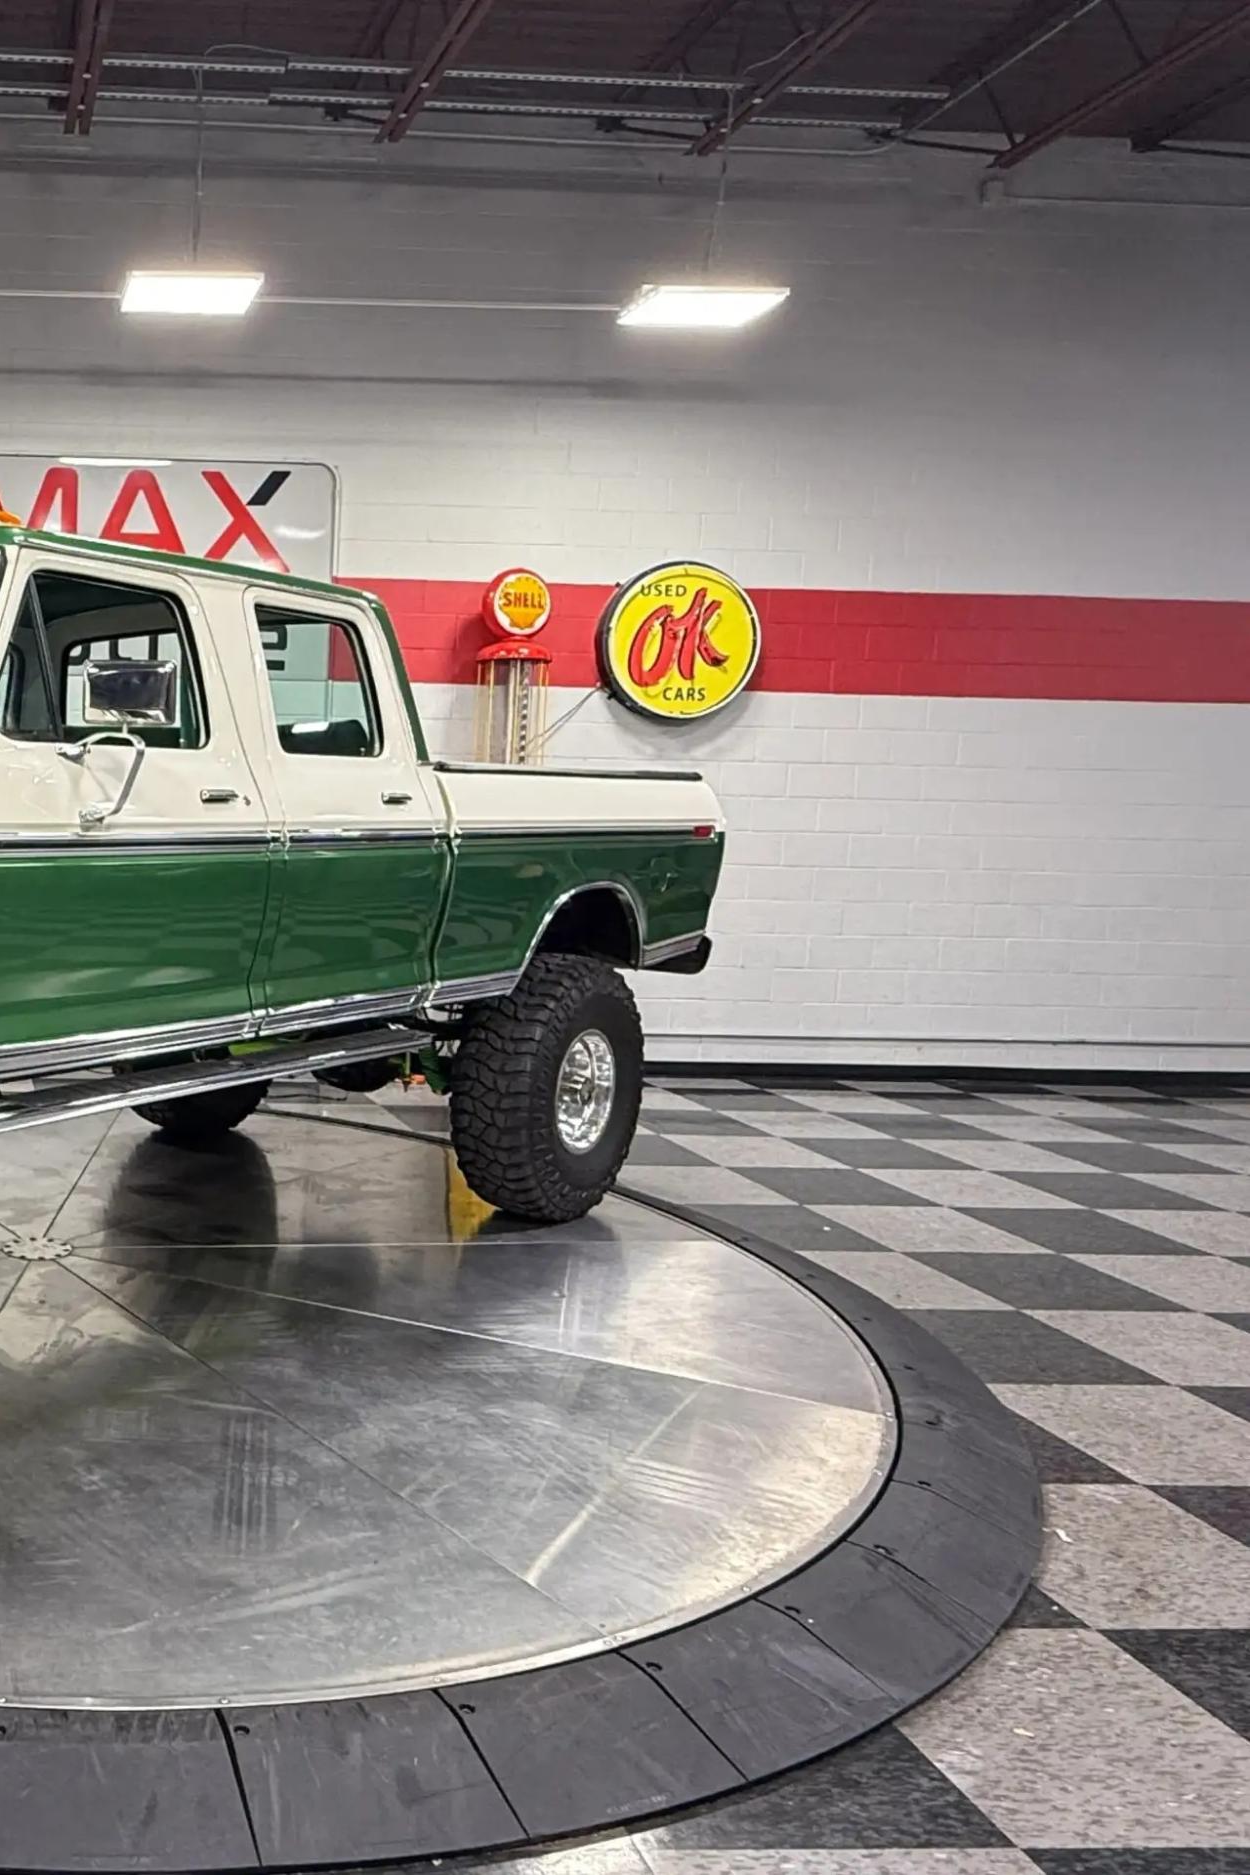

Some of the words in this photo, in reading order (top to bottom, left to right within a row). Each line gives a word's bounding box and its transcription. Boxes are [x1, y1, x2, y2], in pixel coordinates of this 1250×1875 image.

[640, 583, 688, 597] USED
[502, 591, 545, 610] SHELL
[627, 587, 730, 689] OK
[662, 686, 707, 701] CARS
